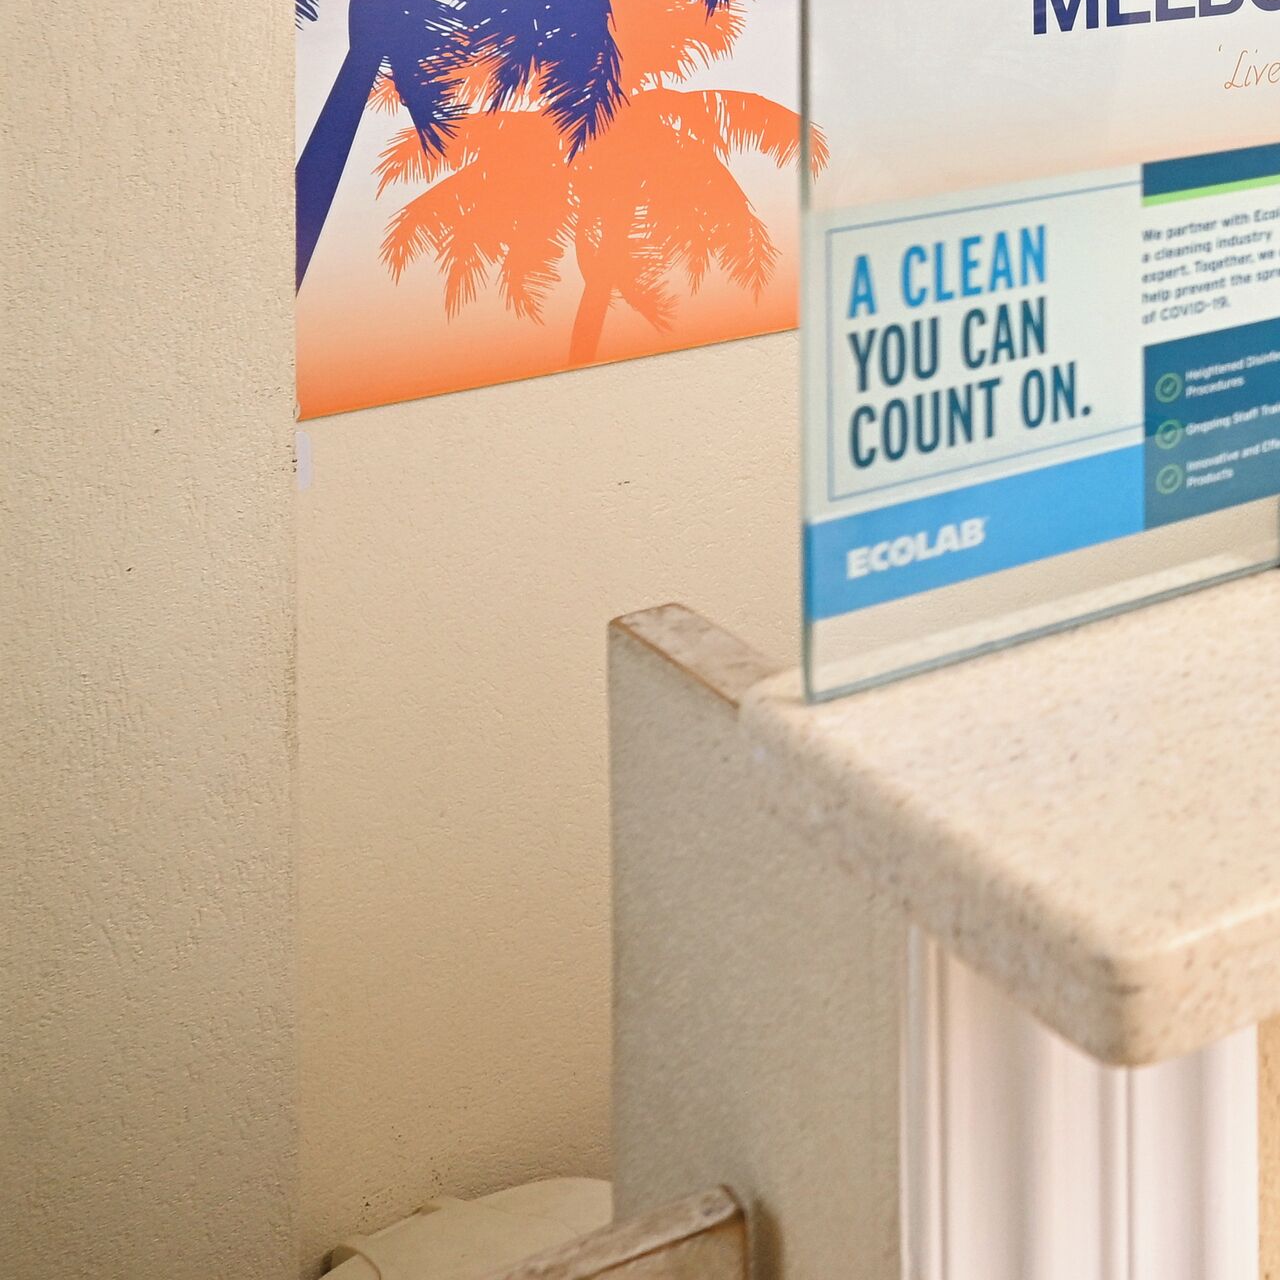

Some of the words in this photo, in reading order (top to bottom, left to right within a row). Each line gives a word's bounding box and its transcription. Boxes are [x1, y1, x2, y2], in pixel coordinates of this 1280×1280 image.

[1142, 229, 1162, 241] We
[1166, 219, 1217, 239] partner
[1221, 213, 1250, 227] with
[1142, 253, 1150, 263] a
[1154, 241, 1212, 261] cleaning
[1216, 230, 1273, 249] industry
[1257, 248, 1275, 261] we
[848, 255, 877, 319] A
[900, 224, 1048, 308] CLEAN
[1141, 288, 1171, 305] help
[1174, 277, 1226, 299] prevent
[1230, 271, 1252, 286] the
[1142, 311, 1156, 325] of
[846, 317, 940, 393] YOU
[960, 297, 1048, 369] CAN
[849, 377, 1000, 469] COUNT
[1020, 362, 1093, 429] ON.
[845, 517, 988, 580] ECOLAB
